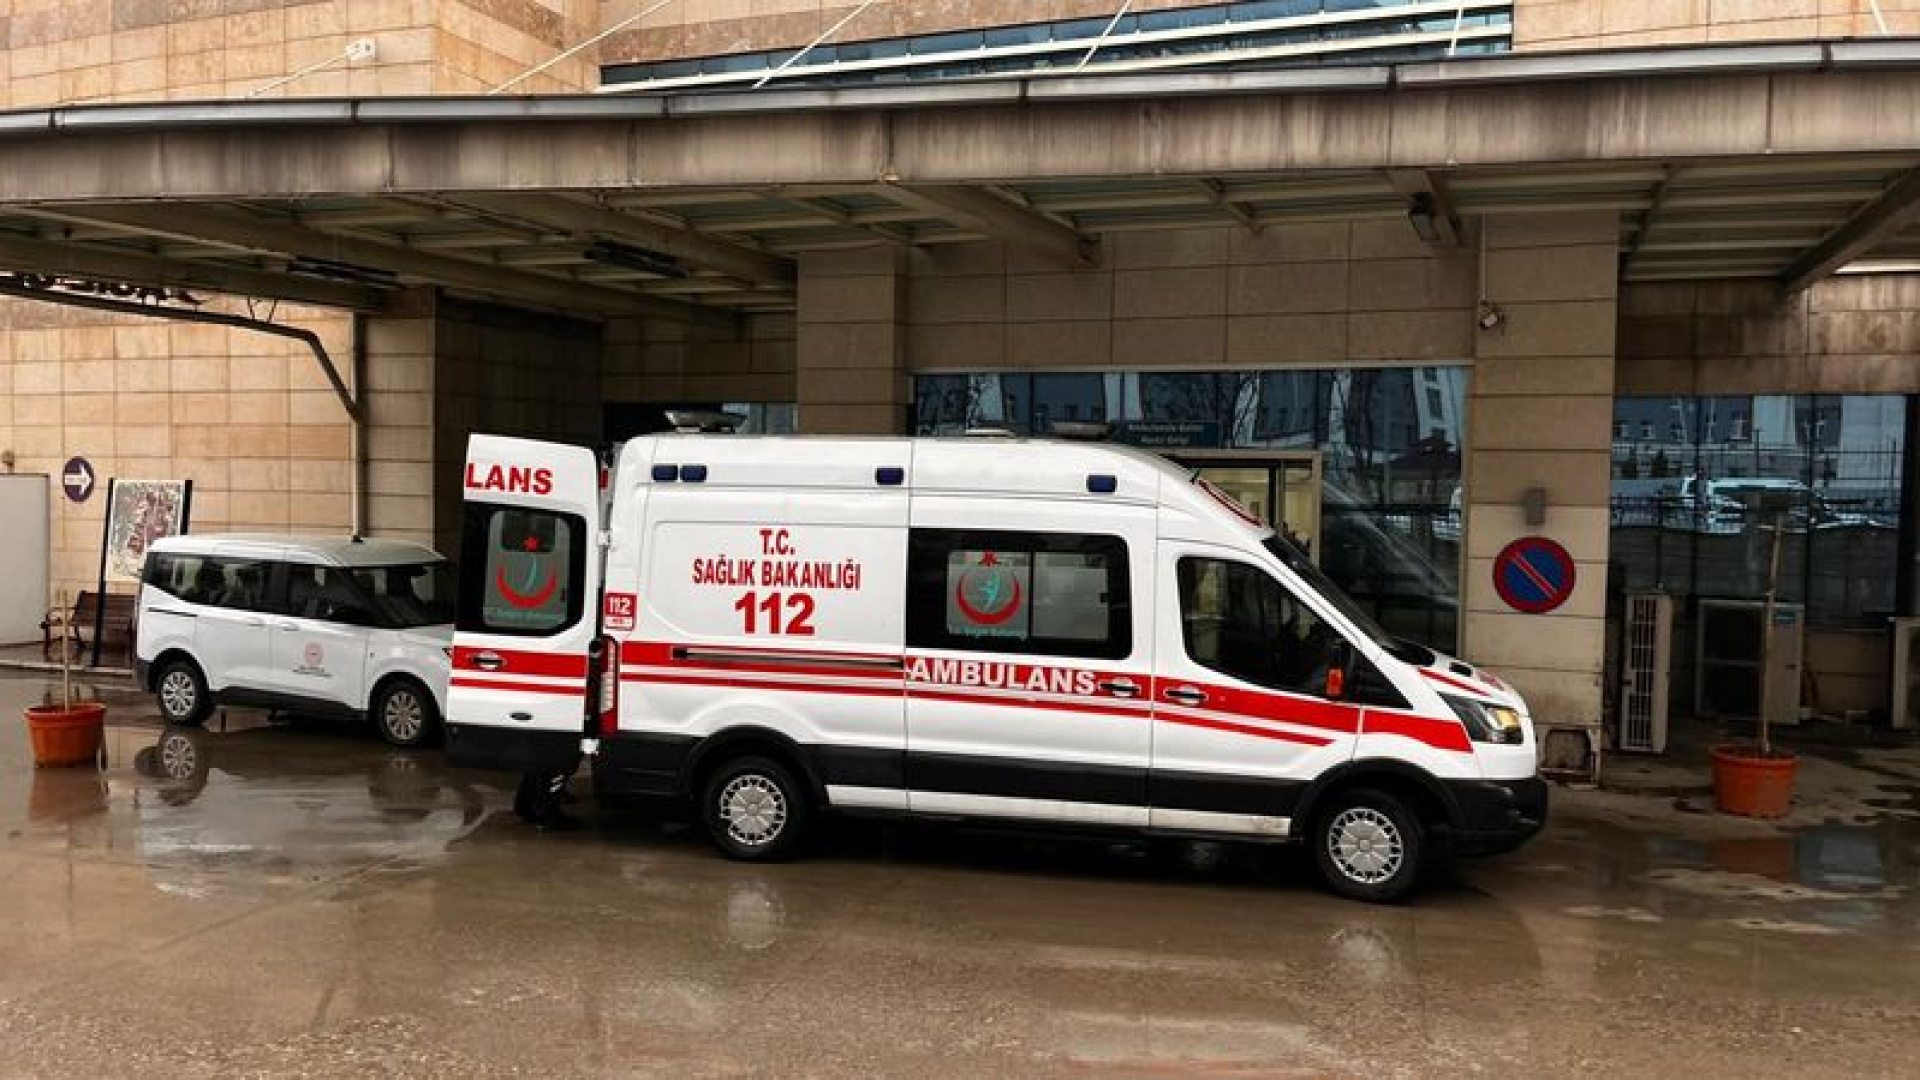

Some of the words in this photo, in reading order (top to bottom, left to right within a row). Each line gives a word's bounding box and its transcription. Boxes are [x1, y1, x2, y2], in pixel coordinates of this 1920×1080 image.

[465, 462, 553, 494] LANS
[759, 529, 796, 555] T.C.
[692, 554, 755, 586] SAĞLIK
[761, 559, 861, 590] BAKANLIĞI
[735, 590, 815, 635] 112
[910, 657, 1095, 695] AMBULANS
